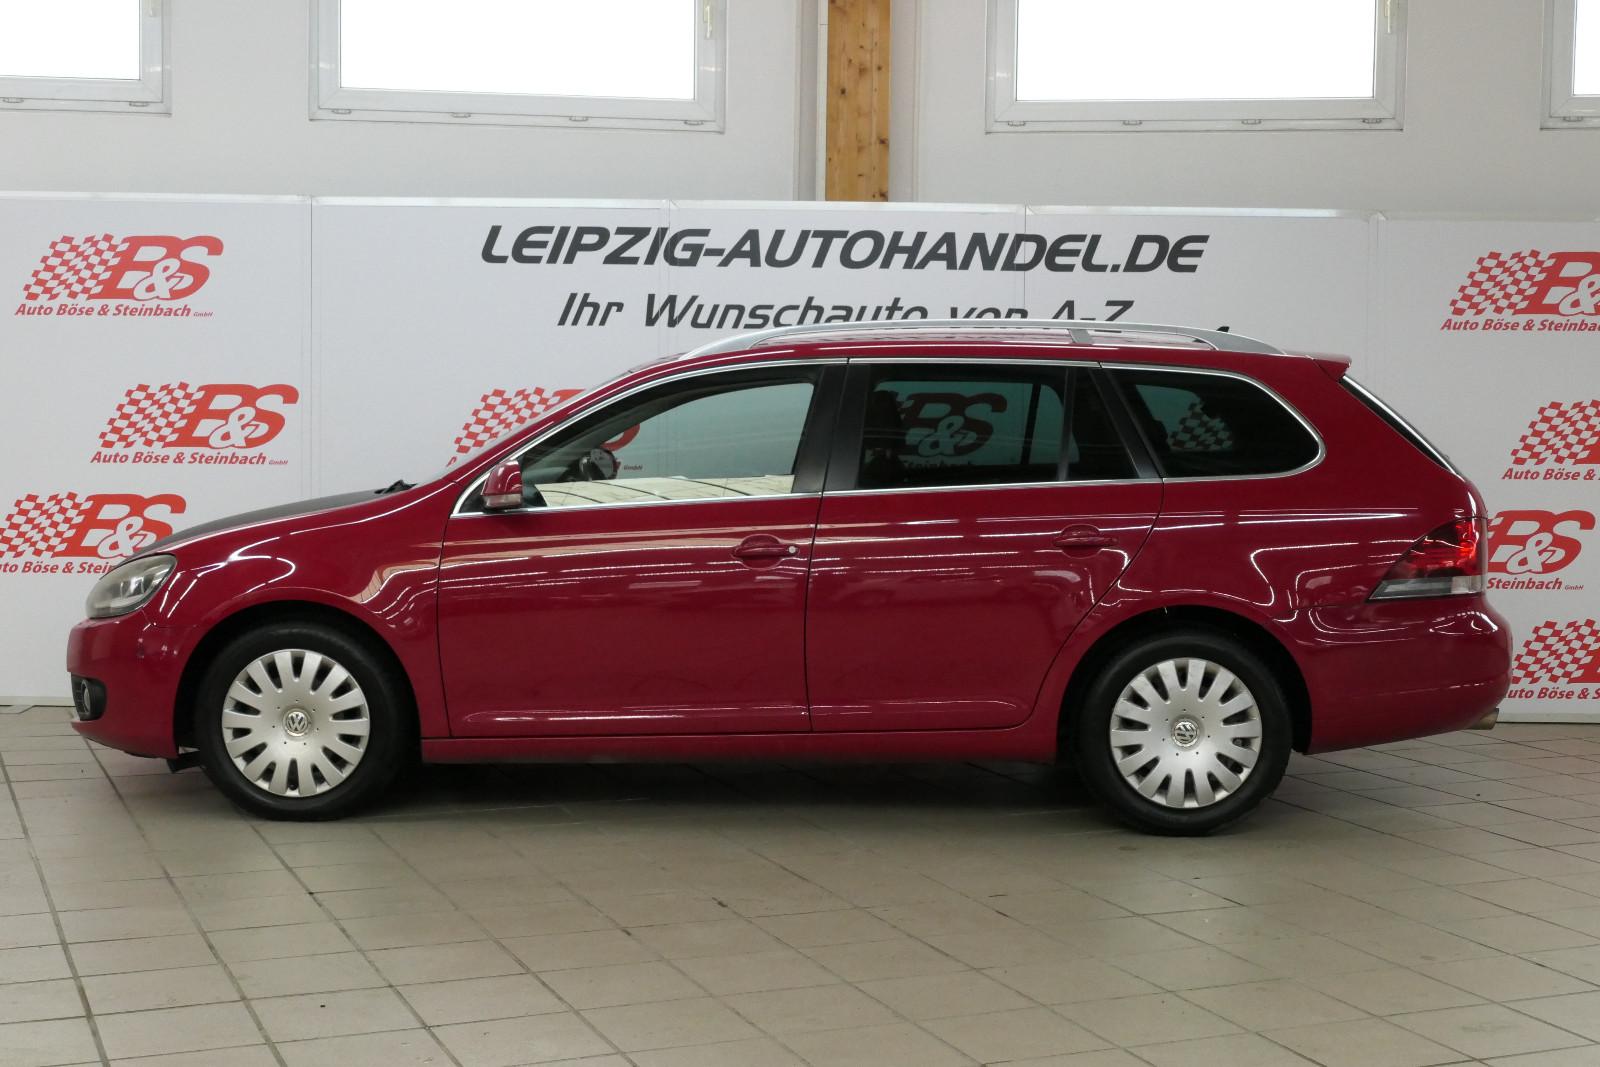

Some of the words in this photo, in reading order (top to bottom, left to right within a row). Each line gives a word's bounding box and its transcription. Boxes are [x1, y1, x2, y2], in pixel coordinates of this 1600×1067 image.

[481, 225, 1209, 273] LEIPZIG-AUTOHANDEL.DE
[87, 235, 224, 301] B&S
[15, 303, 53, 317] Auto
[56, 303, 94, 317] Böse
[97, 304, 110, 317] &
[112, 303, 191, 317] Steinbach
[557, 292, 624, 327] Ihr
[643, 293, 929, 330] Wunschauto
[1440, 318, 1479, 331] Auto
[1482, 318, 1520, 331] Böse
[1522, 319, 1535, 331] &
[1537, 319, 1600, 332] Steinba
[162, 383, 299, 450] B&S
[90, 451, 129, 464] Auto
[132, 450, 170, 464] Böse
[173, 452, 185, 464] &
[187, 451, 266, 465] Steinbach
[1502, 468, 1540, 480] Auto
[1543, 468, 1581, 480] Böse
[1583, 469, 1595, 480] &
[22, 561, 59, 573] Böse
[62, 562, 74, 573] &
[1486, 577, 1562, 590] Steinbach
[1507, 688, 1534, 699] uto
[1537, 687, 1575, 699] Böse
[1577, 688, 1589, 699] &
